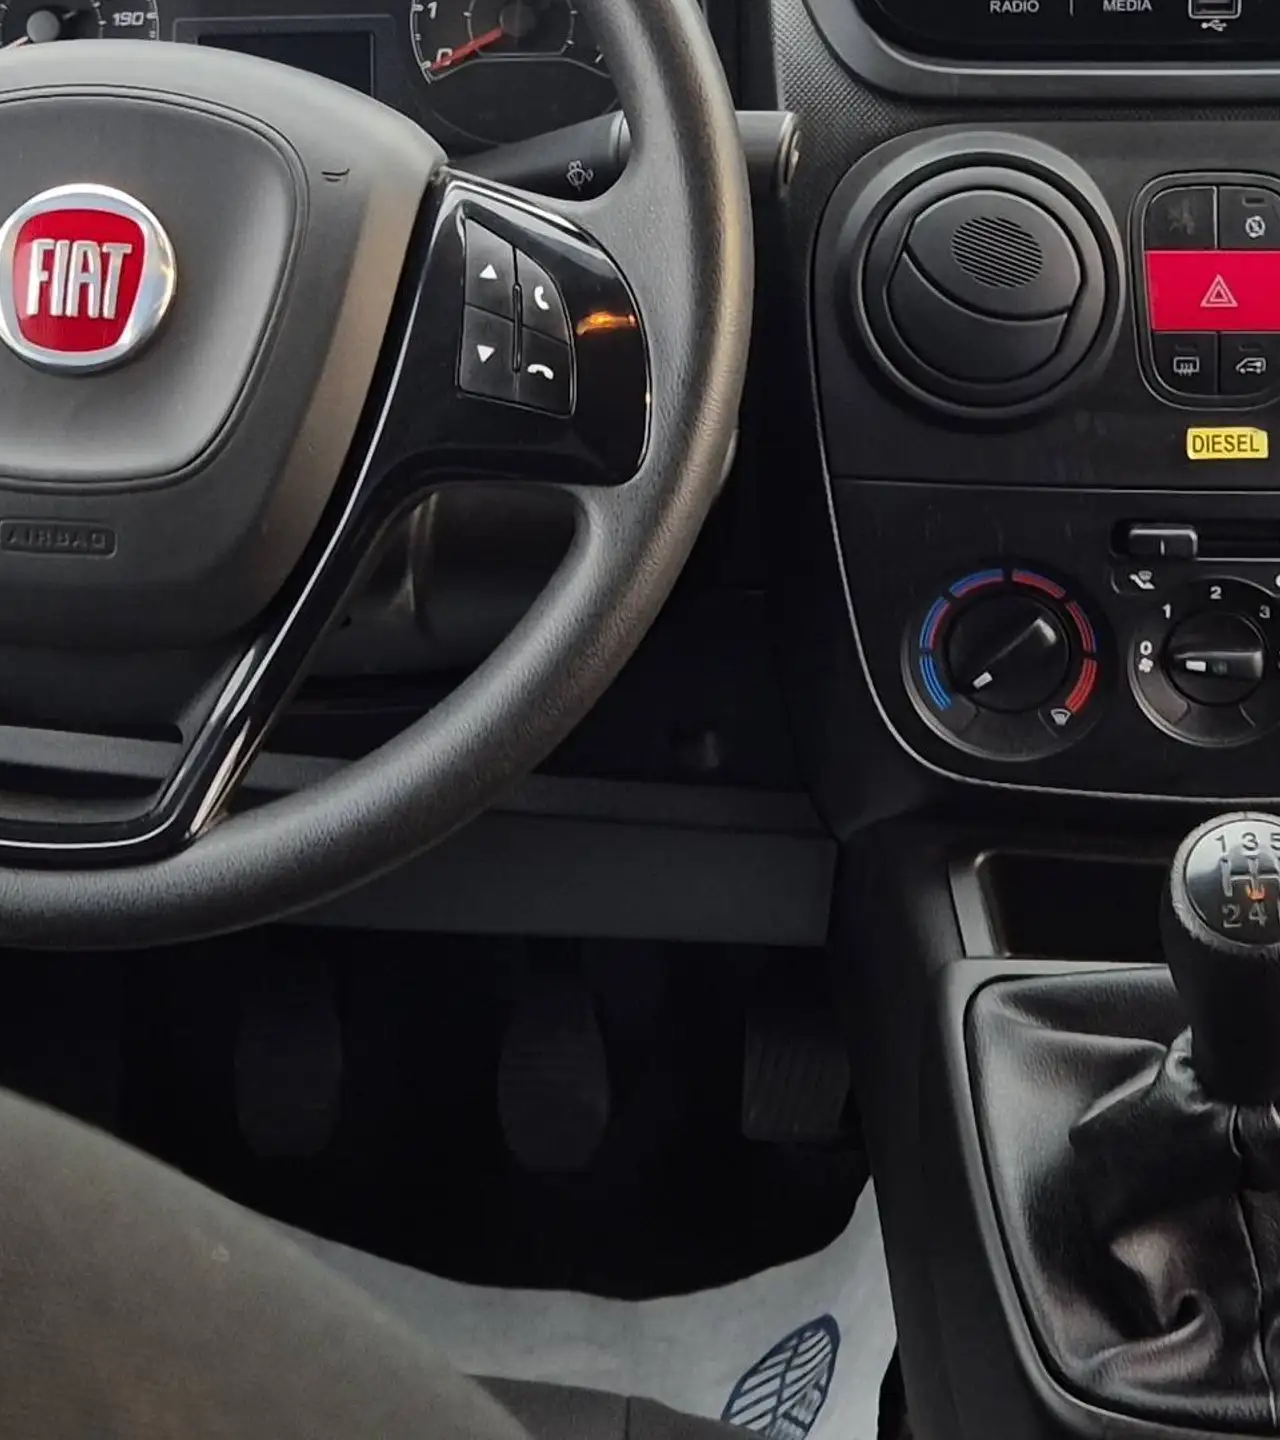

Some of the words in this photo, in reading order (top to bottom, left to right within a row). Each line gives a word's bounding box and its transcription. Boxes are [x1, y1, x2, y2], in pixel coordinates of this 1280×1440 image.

[427, 2, 438, 19] 1
[989, 0, 1040, 13] RADIO
[112, 11, 144, 26] 190
[26, 238, 132, 320] FIAT
[1192, 434, 1260, 453] DIESEL
[1210, 586, 1222, 600] 2
[1162, 603, 1172, 618] 1
[1259, 605, 1271, 618] 3
[1140, 641, 1153, 655] 0
[1215, 834, 1227, 853] 1
[1241, 832, 1259, 851] 3
[1222, 903, 1242, 928] 2
[1248, 902, 1268, 927] 4
